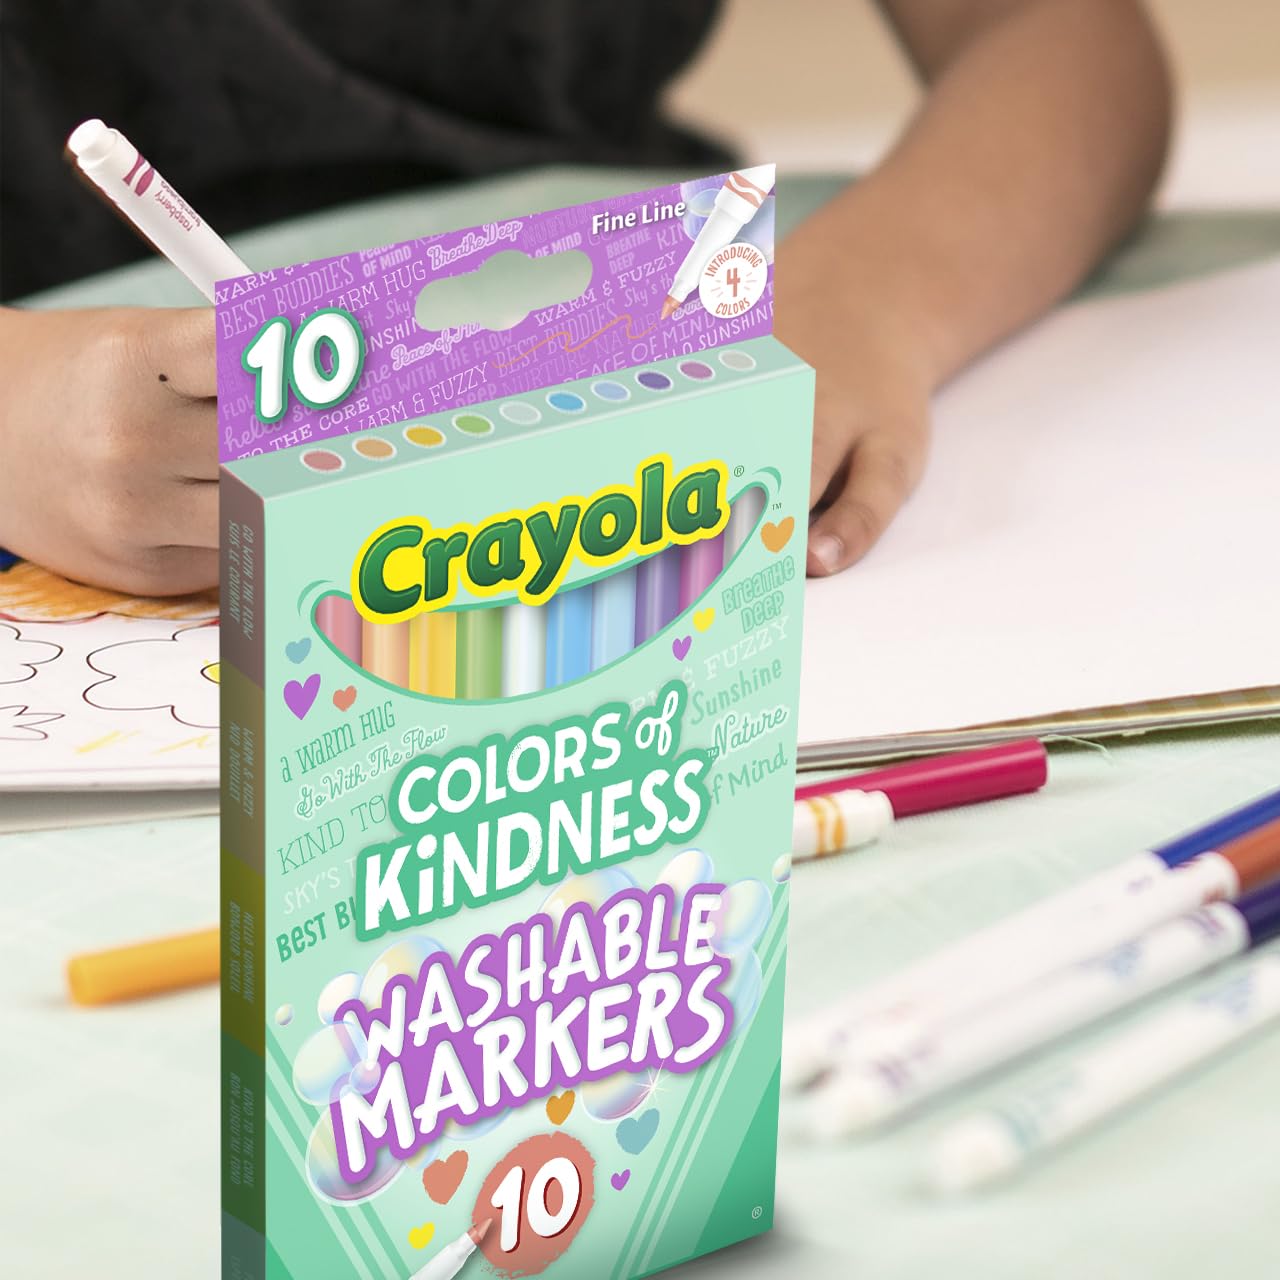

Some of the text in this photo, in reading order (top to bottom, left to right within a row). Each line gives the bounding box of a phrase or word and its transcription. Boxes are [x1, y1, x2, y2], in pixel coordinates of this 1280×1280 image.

[154, 190, 193, 232] raspberry
[592, 201, 686, 235] Fine Line
[363, 259, 377, 278] OF
[427, 232, 485, 271] Breathe
[483, 221, 523, 245] Deep
[608, 252, 636, 275] DEEP
[219, 256, 355, 340] BEST BUDDIES
[382, 260, 426, 296] HUG
[534, 251, 677, 327] WARM & FUZZY
[715, 297, 751, 317] COLORS
[726, 267, 741, 298] 4
[243, 308, 365, 422] 10
[391, 343, 434, 371] Peace
[496, 335, 538, 377] BEST
[543, 298, 620, 356] BUDDIES
[631, 335, 657, 362] OF
[662, 311, 716, 349] MIND
[371, 383, 393, 407] GO
[395, 360, 438, 396] WITH
[440, 346, 472, 375] THE
[473, 329, 513, 359] FLOW
[413, 392, 426, 414] &
[428, 361, 488, 406] FUZZY
[269, 423, 313, 452] THE
[319, 396, 370, 431] CORE
[356, 459, 724, 616] Crayola
[703, 615, 790, 681] FUZZY
[690, 658, 783, 725] Sunshine
[398, 689, 680, 825] COLORS of
[713, 706, 789, 757] Nature
[296, 726, 448, 819] Go With The Flow
[727, 742, 789, 796] Mind
[276, 817, 345, 876] KIND
[350, 794, 387, 833] TO
[343, 892, 724, 1071] WASHABLE
[339, 964, 725, 1174] MARKERS
[490, 1156, 583, 1253] 10
